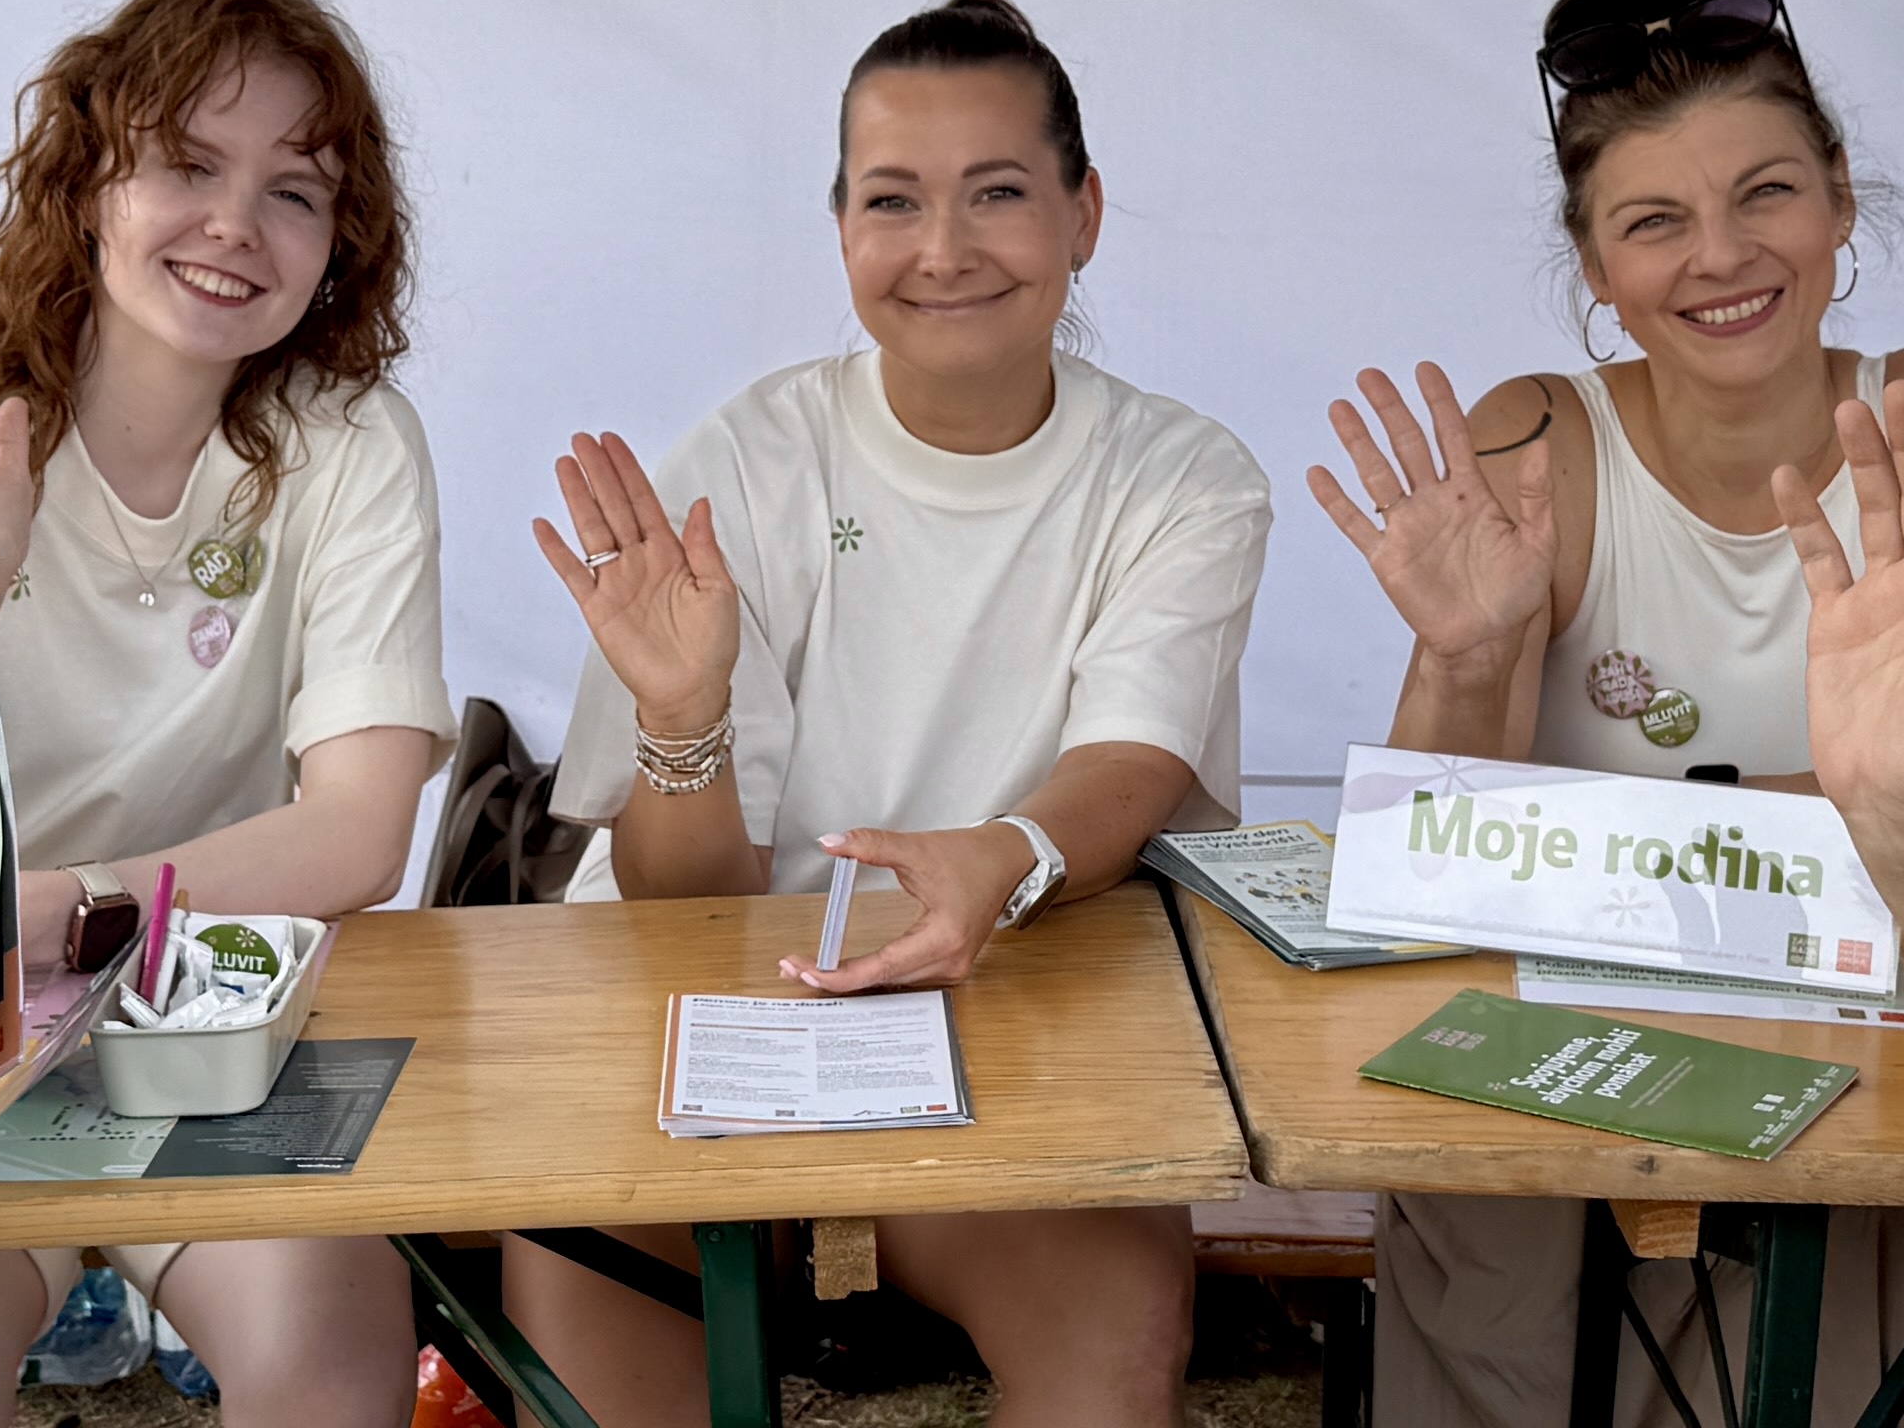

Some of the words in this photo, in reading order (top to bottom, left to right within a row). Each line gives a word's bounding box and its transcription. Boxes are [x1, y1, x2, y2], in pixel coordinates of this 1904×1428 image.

[1407, 789, 1578, 882] Moje
[1604, 822, 1825, 899] rodina
[213, 951, 266, 971] LUVIT
[1510, 1036, 1600, 1089] Spojujeme,
[1538, 1060, 1607, 1104] abychom
[1595, 1028, 1642, 1062] mohli
[1593, 1052, 1657, 1099] pomáhat
